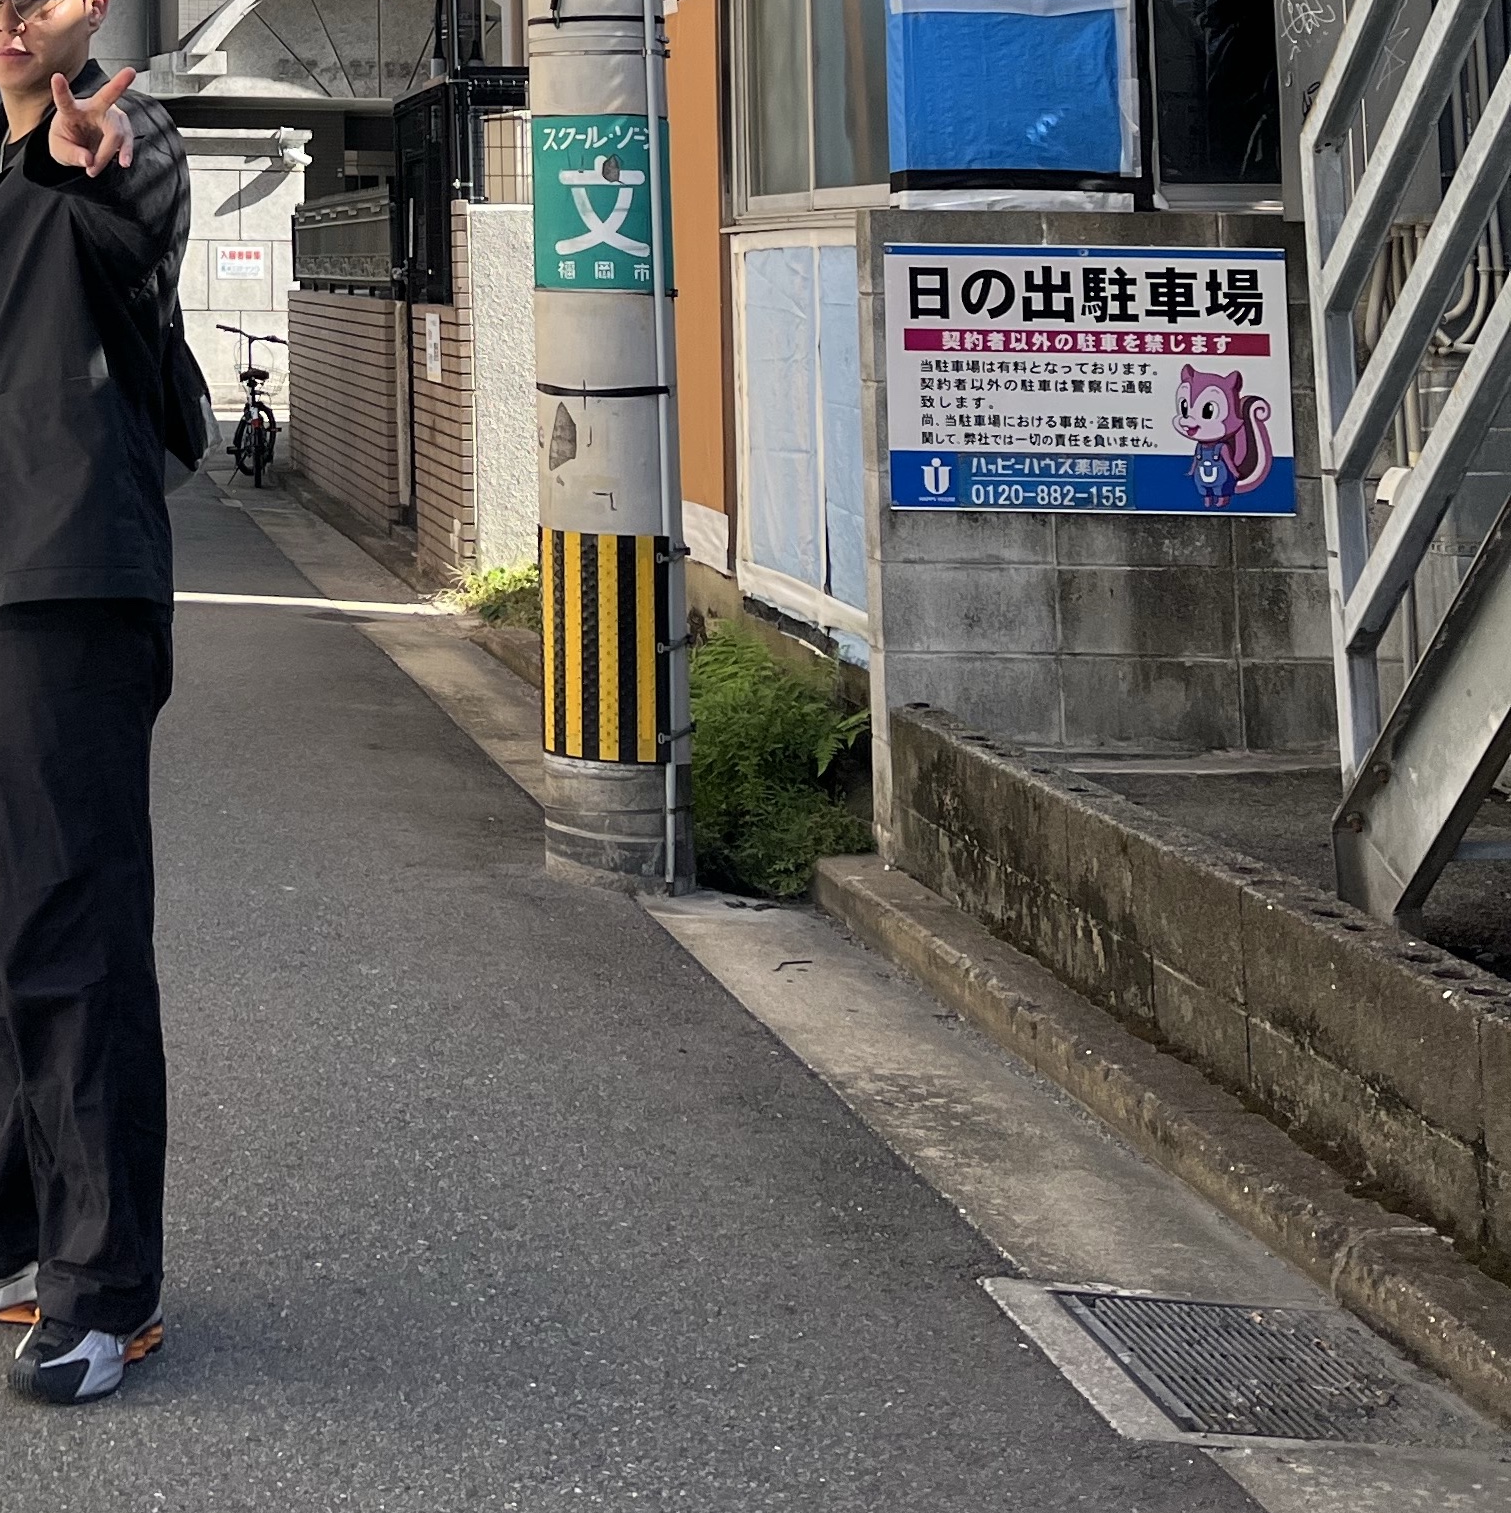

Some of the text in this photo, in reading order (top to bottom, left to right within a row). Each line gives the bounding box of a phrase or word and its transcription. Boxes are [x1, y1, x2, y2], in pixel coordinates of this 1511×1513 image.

[558, 260, 650, 282] 福岡市
[908, 265, 1265, 327] 日の出駐車場
[941, 331, 1233, 355] 契約者以外の駐車を禁じます
[920, 359, 1159, 376] 当駐車場は有料となっております。
[920, 377, 1153, 394] 契約者以外の駐車は警察に通報
[920, 395, 994, 410] 致します。
[921, 414, 1154, 430] 尚、当駐車場における事故・盗難等に
[971, 457, 1127, 477] ハッピーハウス薬院店
[971, 484, 1127, 506] 0120-882-155
